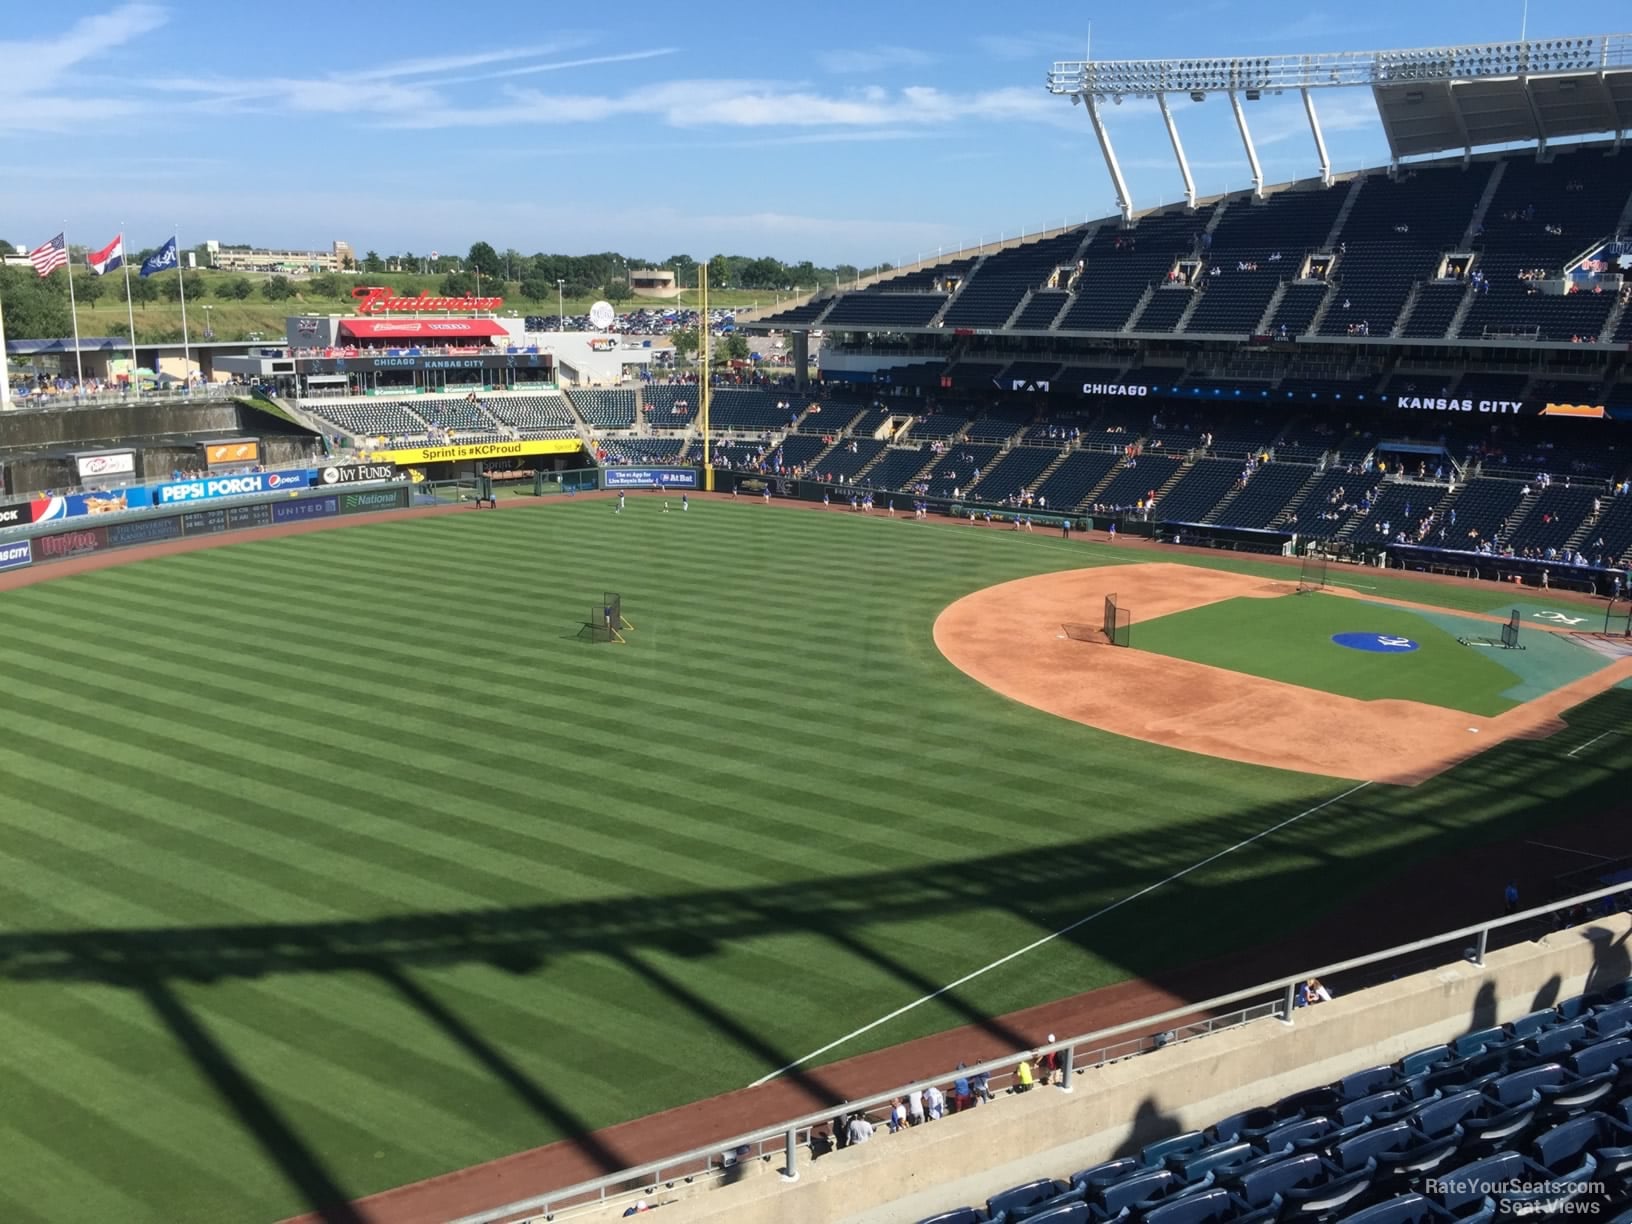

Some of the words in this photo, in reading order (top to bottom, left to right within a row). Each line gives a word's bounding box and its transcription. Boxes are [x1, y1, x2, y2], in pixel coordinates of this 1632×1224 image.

[352, 287, 503, 314] Budweiser
[1083, 384, 1147, 396] CHICAGO
[1398, 397, 1473, 412] KANSAS
[1479, 400, 1522, 414] CITY
[423, 448, 456, 460] Sprint
[458, 446, 466, 456] is
[469, 444, 521, 456] #KCProud
[484, 460, 512, 470] Sprint
[280, 476, 300, 485] pepsi
[162, 482, 204, 502] PEPSI
[208, 476, 262, 496] PORCH
[358, 493, 396, 506] National
[278, 504, 322, 516] UNITED
[10, 547, 28, 560] CITY
